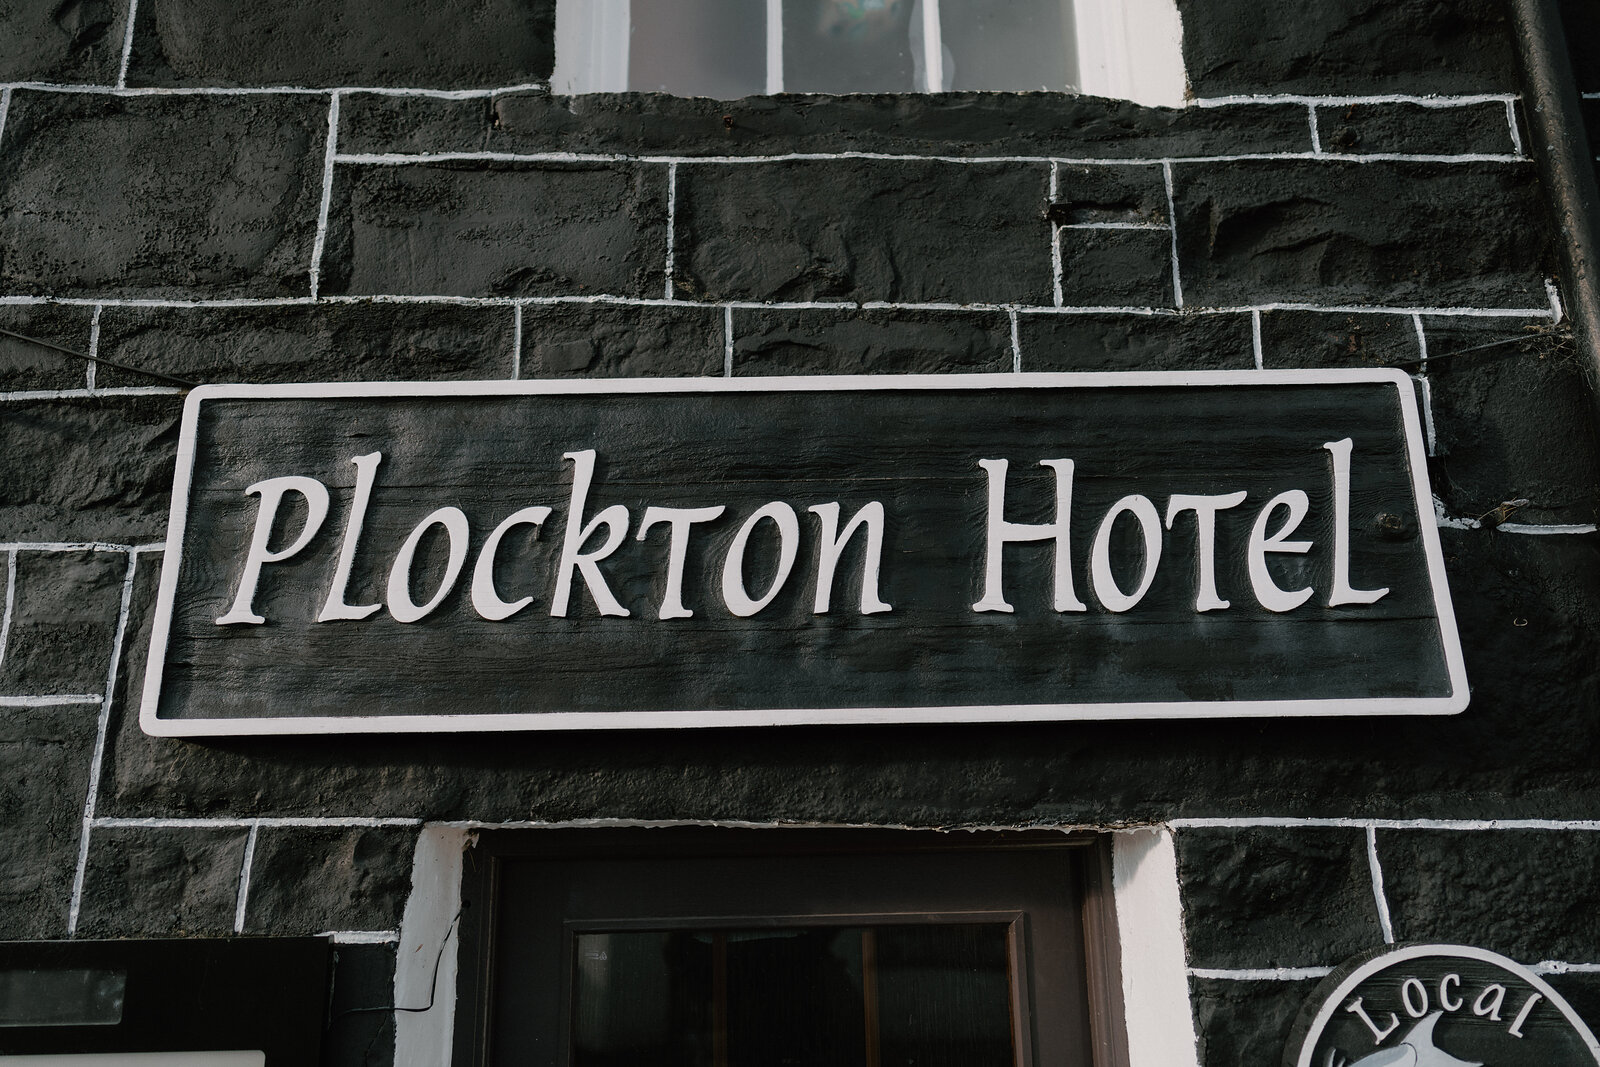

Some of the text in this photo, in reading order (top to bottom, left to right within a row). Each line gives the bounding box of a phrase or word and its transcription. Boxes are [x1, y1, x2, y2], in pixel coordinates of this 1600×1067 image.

[215, 437, 1390, 625] Plockton Hotel
[1346, 974, 1543, 1045] Local
